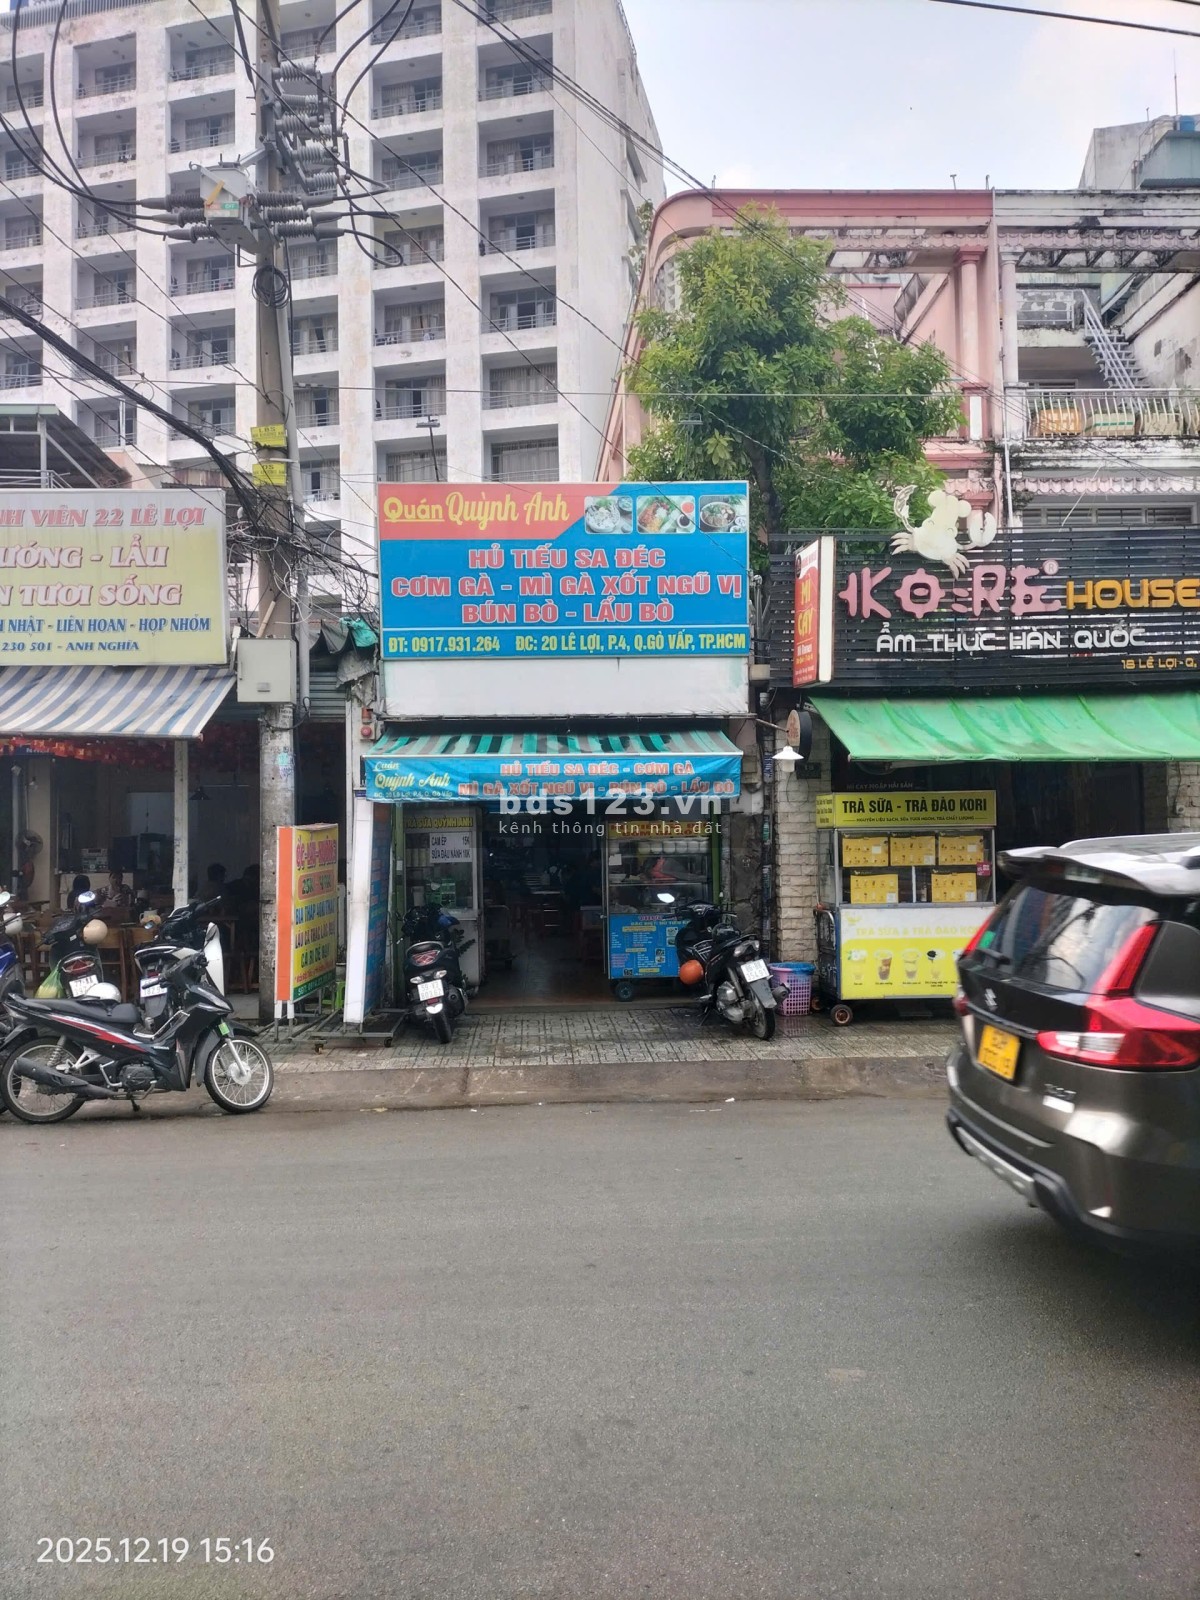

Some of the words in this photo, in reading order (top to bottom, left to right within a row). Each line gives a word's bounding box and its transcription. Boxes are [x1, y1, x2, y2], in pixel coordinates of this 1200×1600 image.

[30, 504, 88, 527] VIÊN
[93, 508, 123, 527] 22
[163, 507, 206, 531] LỢI
[383, 497, 445, 522] Quán
[446, 492, 519, 530] Quỳnh
[523, 492, 570, 525] Anh
[90, 554, 103, 562] -
[109, 534, 169, 567] LẨU
[469, 543, 504, 568] HỦ
[511, 543, 567, 568] TIẾU
[575, 549, 609, 568] SA
[614, 545, 666, 568] ĐÉC
[19, 582, 93, 606] TƯƠI
[98, 574, 182, 606] SỐNG
[391, 575, 451, 596] CƠM
[459, 572, 494, 596] GÀ
[519, 572, 552, 596] MÌ
[560, 572, 595, 595] GÀ
[601, 569, 651, 595] XỐT
[657, 571, 710, 595] NGŨ
[717, 575, 742, 598] VỊ
[1066, 578, 1200, 610] HOUSE
[462, 600, 516, 623] BÚN
[524, 600, 558, 623] BÒ
[583, 596, 632, 622] LẨU
[639, 598, 674, 622] BÒ
[8, 615, 44, 637] NHẬT
[56, 615, 84, 632] LIÊN
[88, 618, 126, 632] HOAN
[876, 622, 916, 653] ẨM
[927, 631, 996, 657] THỰC
[1009, 627, 1061, 650] HÀN
[1073, 618, 1146, 649] QUỐC
[2, 641, 26, 651] 230
[29, 641, 52, 651] 501
[66, 641, 94, 651] ANH
[388, 637, 408, 652] ĐT:
[411, 636, 501, 652] 0917.931.264
[515, 636, 538, 651] ĐC:
[541, 635, 558, 651] 20
[561, 632, 576, 650] LÊ
[580, 635, 604, 653] LỢI,
[607, 635, 630, 651] P.4,
[634, 631, 664, 650] Q.GÒ
[668, 629, 695, 651] VẤP,
[699, 633, 746, 649] TP.HCM
[1139, 656, 1155, 669] LÊ
[1158, 658, 1177, 671] LỢI
[501, 760, 522, 776] HỦ
[526, 760, 560, 776] TIẾU
[563, 763, 584, 776] SA
[588, 761, 619, 775] ĐÉC
[634, 761, 670, 775] CƠM
[673, 760, 695, 775] GÀ
[375, 773, 415, 791] Quỳnh
[419, 773, 450, 787] Anh
[458, 780, 479, 795] MÌ
[483, 780, 504, 795] GÀ
[508, 778, 538, 795] XỐT
[542, 780, 575, 795] NGŨ
[609, 780, 641, 795] BÚN
[645, 779, 667, 794] BÒ
[681, 777, 710, 794] LẨU
[713, 779, 735, 794] BÒ
[842, 798, 865, 813] TRÀ
[869, 797, 893, 813] SỮA
[905, 796, 928, 812] TRÀ
[931, 796, 956, 811] ĐÀO
[960, 798, 987, 811] KORI
[458, 815, 473, 827] ANH
